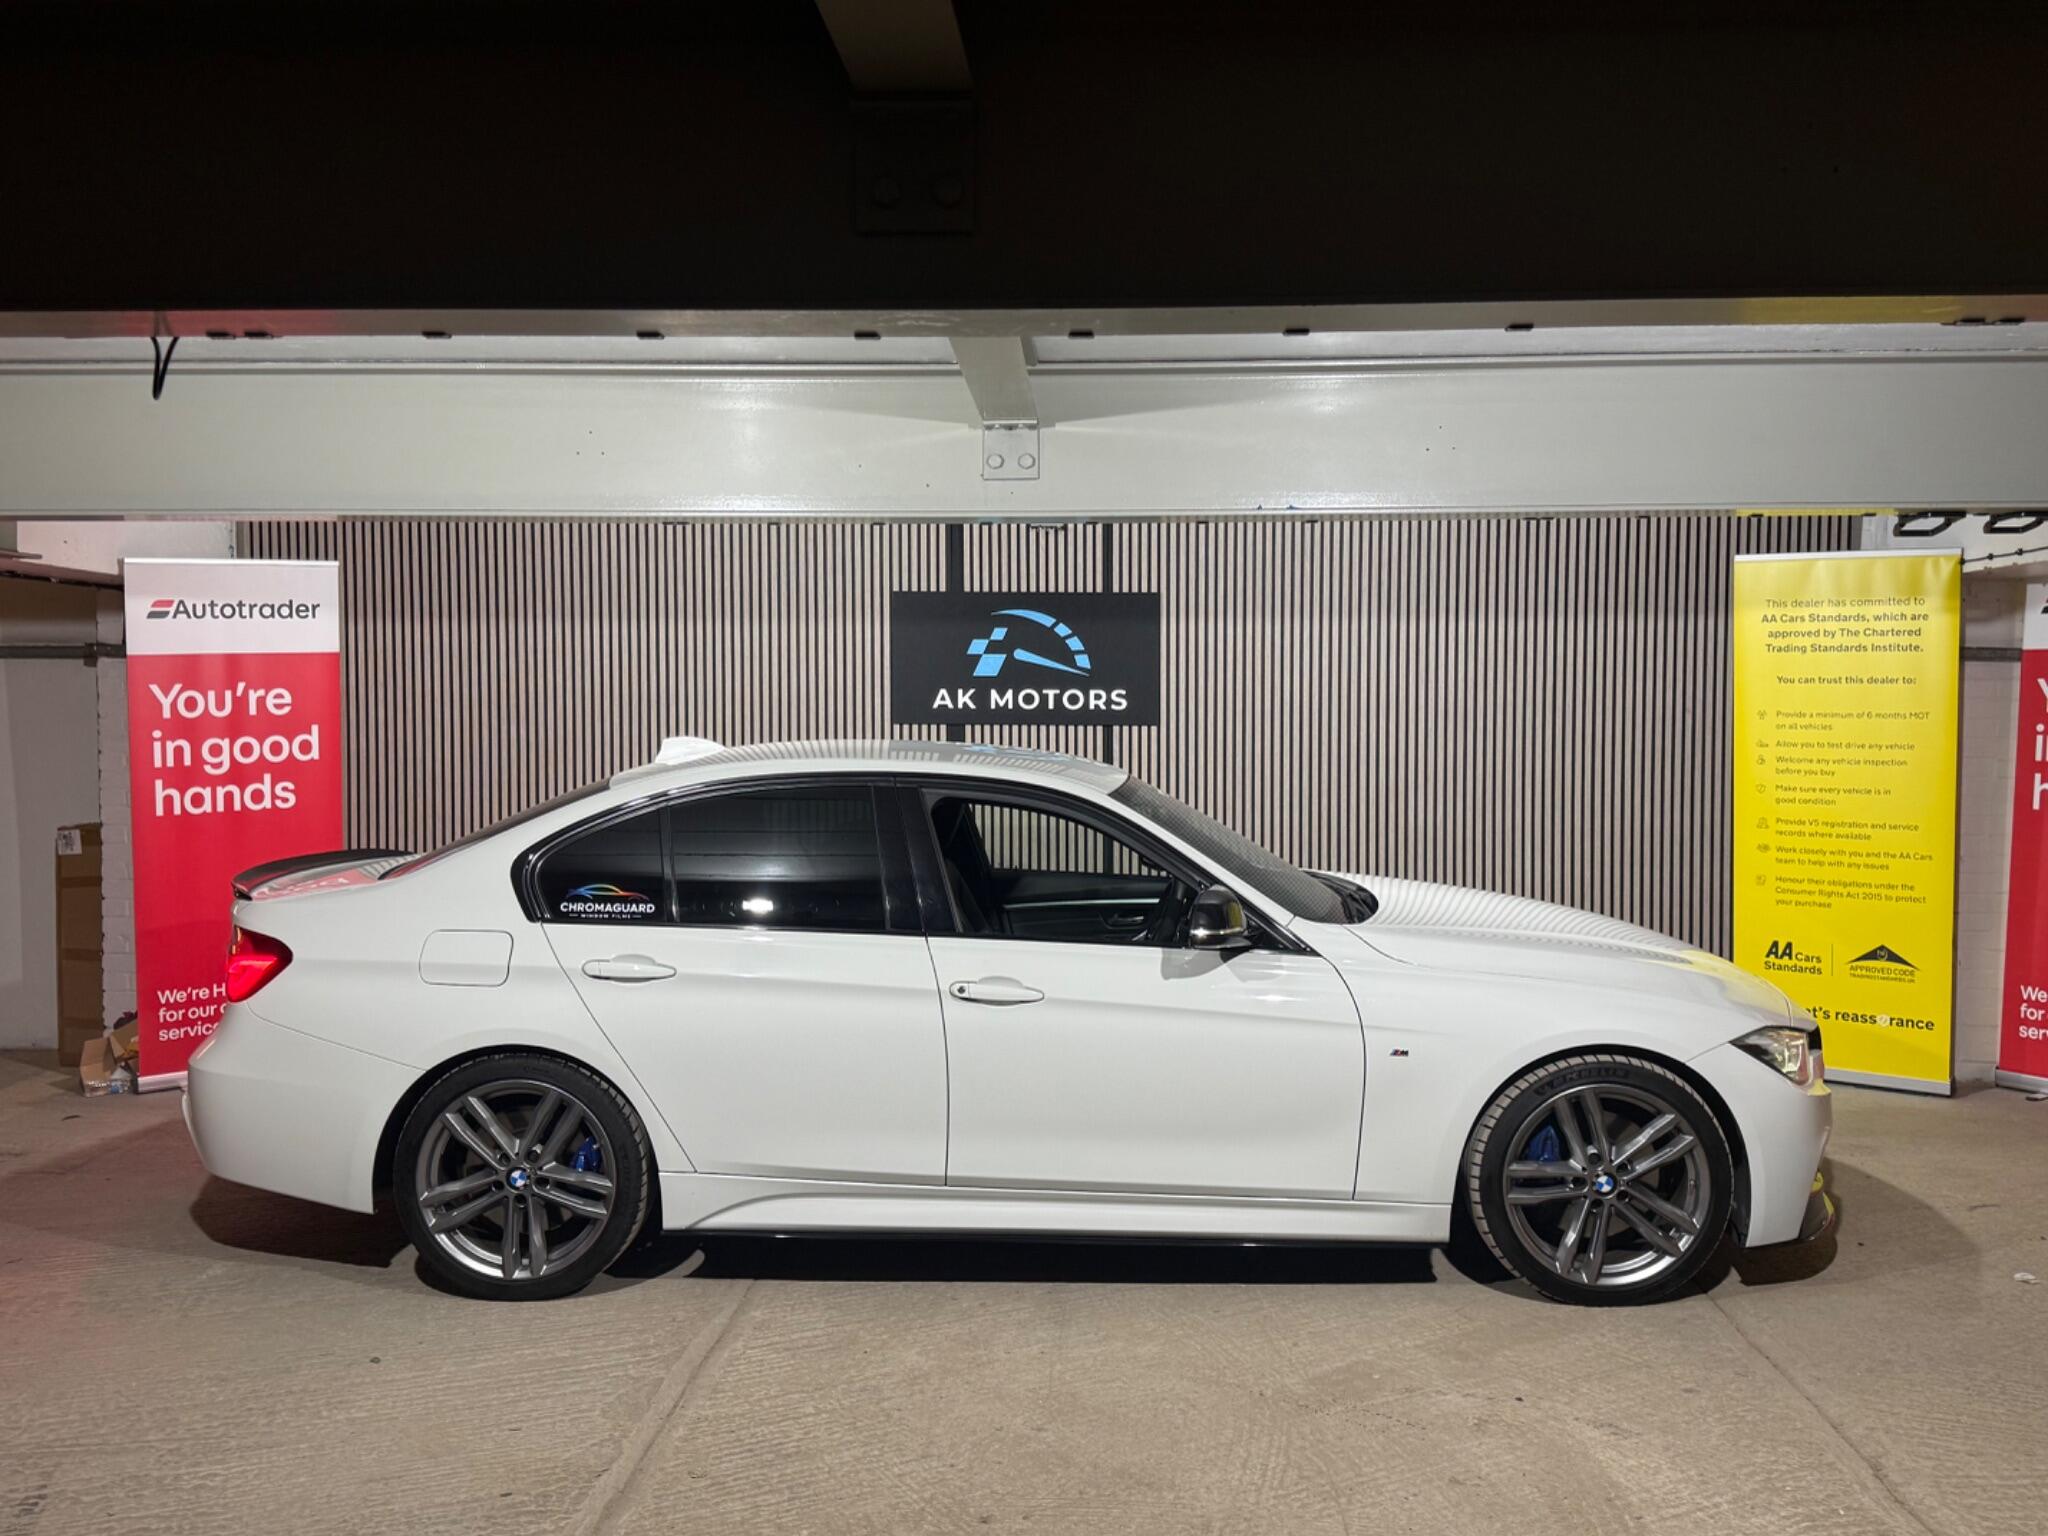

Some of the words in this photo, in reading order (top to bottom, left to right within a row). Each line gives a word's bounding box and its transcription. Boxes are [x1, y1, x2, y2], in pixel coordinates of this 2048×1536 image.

[1766, 599, 1787, 608] This
[1791, 599, 1824, 608] dealer
[1827, 598, 1847, 608] has
[1850, 597, 1910, 606] committed
[1914, 598, 1925, 606] to
[172, 600, 320, 619] Autotrader
[1761, 614, 1777, 623] AA
[1780, 614, 1805, 622] Cars
[1808, 613, 1870, 623] Standards,
[1873, 613, 1907, 622] which
[1768, 628, 1820, 639] approved
[1823, 628, 1836, 639] by
[1839, 628, 1860, 637] The
[1863, 627, 1921, 637] Chartered
[1766, 644, 1807, 654] Trading
[1811, 643, 1867, 652] Standards
[1871, 643, 1923, 652] Institute.
[1777, 676, 1794, 684] You
[1818, 676, 1841, 684] trust
[1845, 676, 1863, 684] this
[1867, 676, 1898, 684] dealer
[1902, 676, 1916, 684] to:
[149, 682, 292, 719] You're
[932, 689, 976, 709] AK
[990, 689, 1128, 710] MOTORS
[1776, 711, 1807, 719] Provide
[1875, 712, 1907, 720] months
[1910, 712, 1930, 720] MOT
[1800, 723, 1832, 731] vehicles
[152, 730, 191, 768] in
[201, 724, 320, 775] good
[1800, 742, 1814, 751] you
[1776, 756, 1813, 764] Welcome
[155, 773, 296, 816] hands
[1775, 784, 1797, 792] Make
[1819, 786, 1841, 795] every
[1843, 787, 1872, 795] vehicle
[1776, 797, 1796, 806] good
[1798, 797, 1836, 806] condition
[1776, 817, 1805, 826] Provide
[1822, 820, 1868, 829] registration
[1888, 823, 1919, 831] service
[1776, 829, 1806, 837] records
[1808, 831, 1833, 839] where
[1776, 845, 1797, 853] Work
[1799, 847, 1827, 856] closely
[1829, 848, 1846, 856] with
[1883, 851, 1897, 859] the
[1913, 853, 1933, 861] Cars
[1808, 859, 1825, 867] help
[1827, 860, 1845, 868] with
[1863, 862, 1889, 870] issues
[1776, 876, 1805, 884] Honour
[1807, 877, 1825, 885] their
[1827, 879, 1872, 890] obligations
[1874, 882, 1898, 890] under
[1901, 883, 1914, 891] the
[1776, 887, 1816, 896] Consumer
[1818, 889, 1844, 898] Rights
[1895, 895, 1926, 904] protect
[560, 902, 655, 913] CHROMAGUARD
[1795, 900, 1832, 908] purchase
[1765, 940, 1792, 960] AA
[1795, 952, 1822, 963] Cars
[1764, 961, 1822, 975] Standards
[159, 1008, 185, 1023] for
[188, 1004, 217, 1019] our
[2020, 1003, 2045, 1021] for
